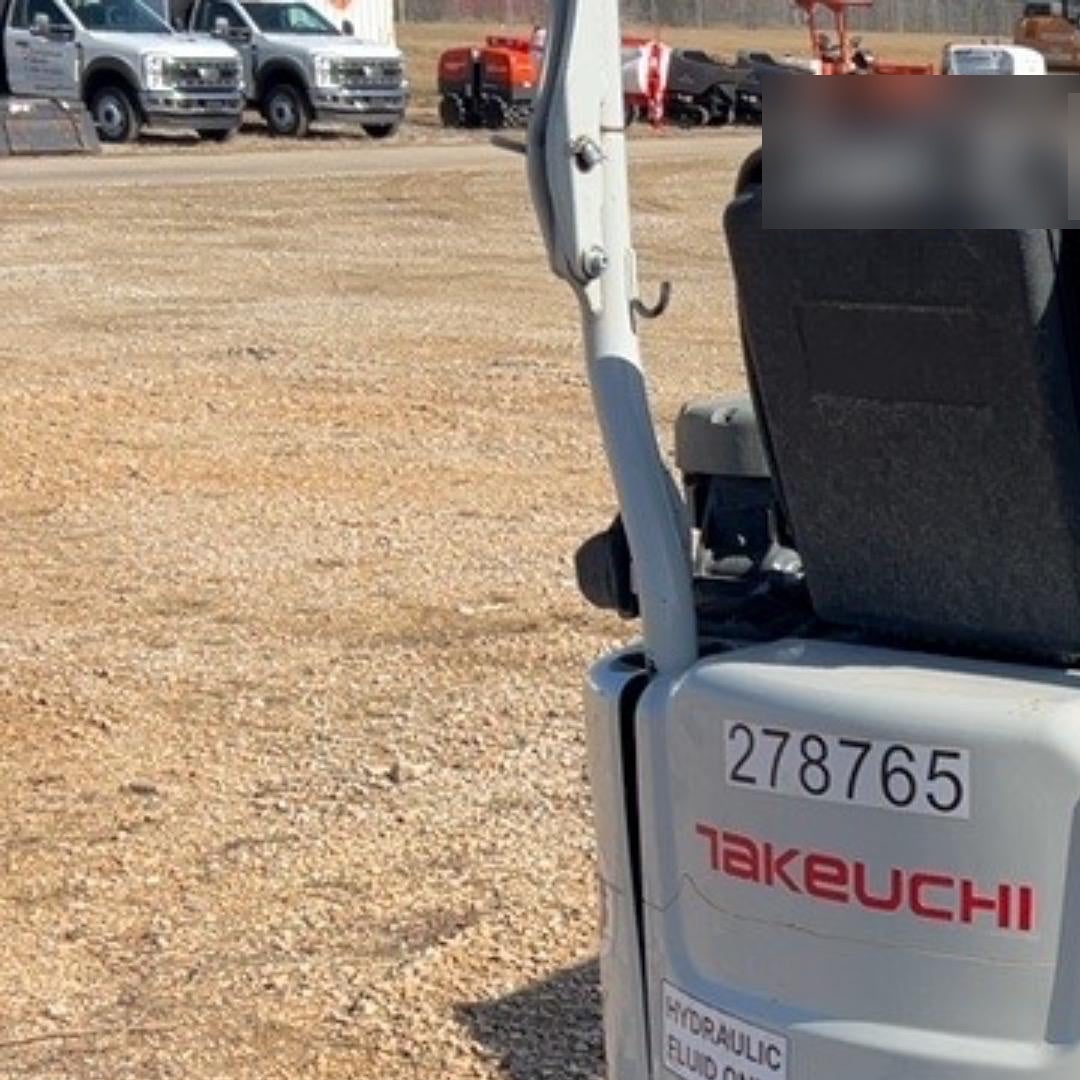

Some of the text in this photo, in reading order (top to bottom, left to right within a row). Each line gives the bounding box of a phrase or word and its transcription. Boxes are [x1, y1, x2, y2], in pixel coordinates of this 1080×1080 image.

[728, 721, 964, 813] 278765
[665, 995, 781, 1071] HYDRAULIC
[668, 1034, 718, 1080] FLUID
